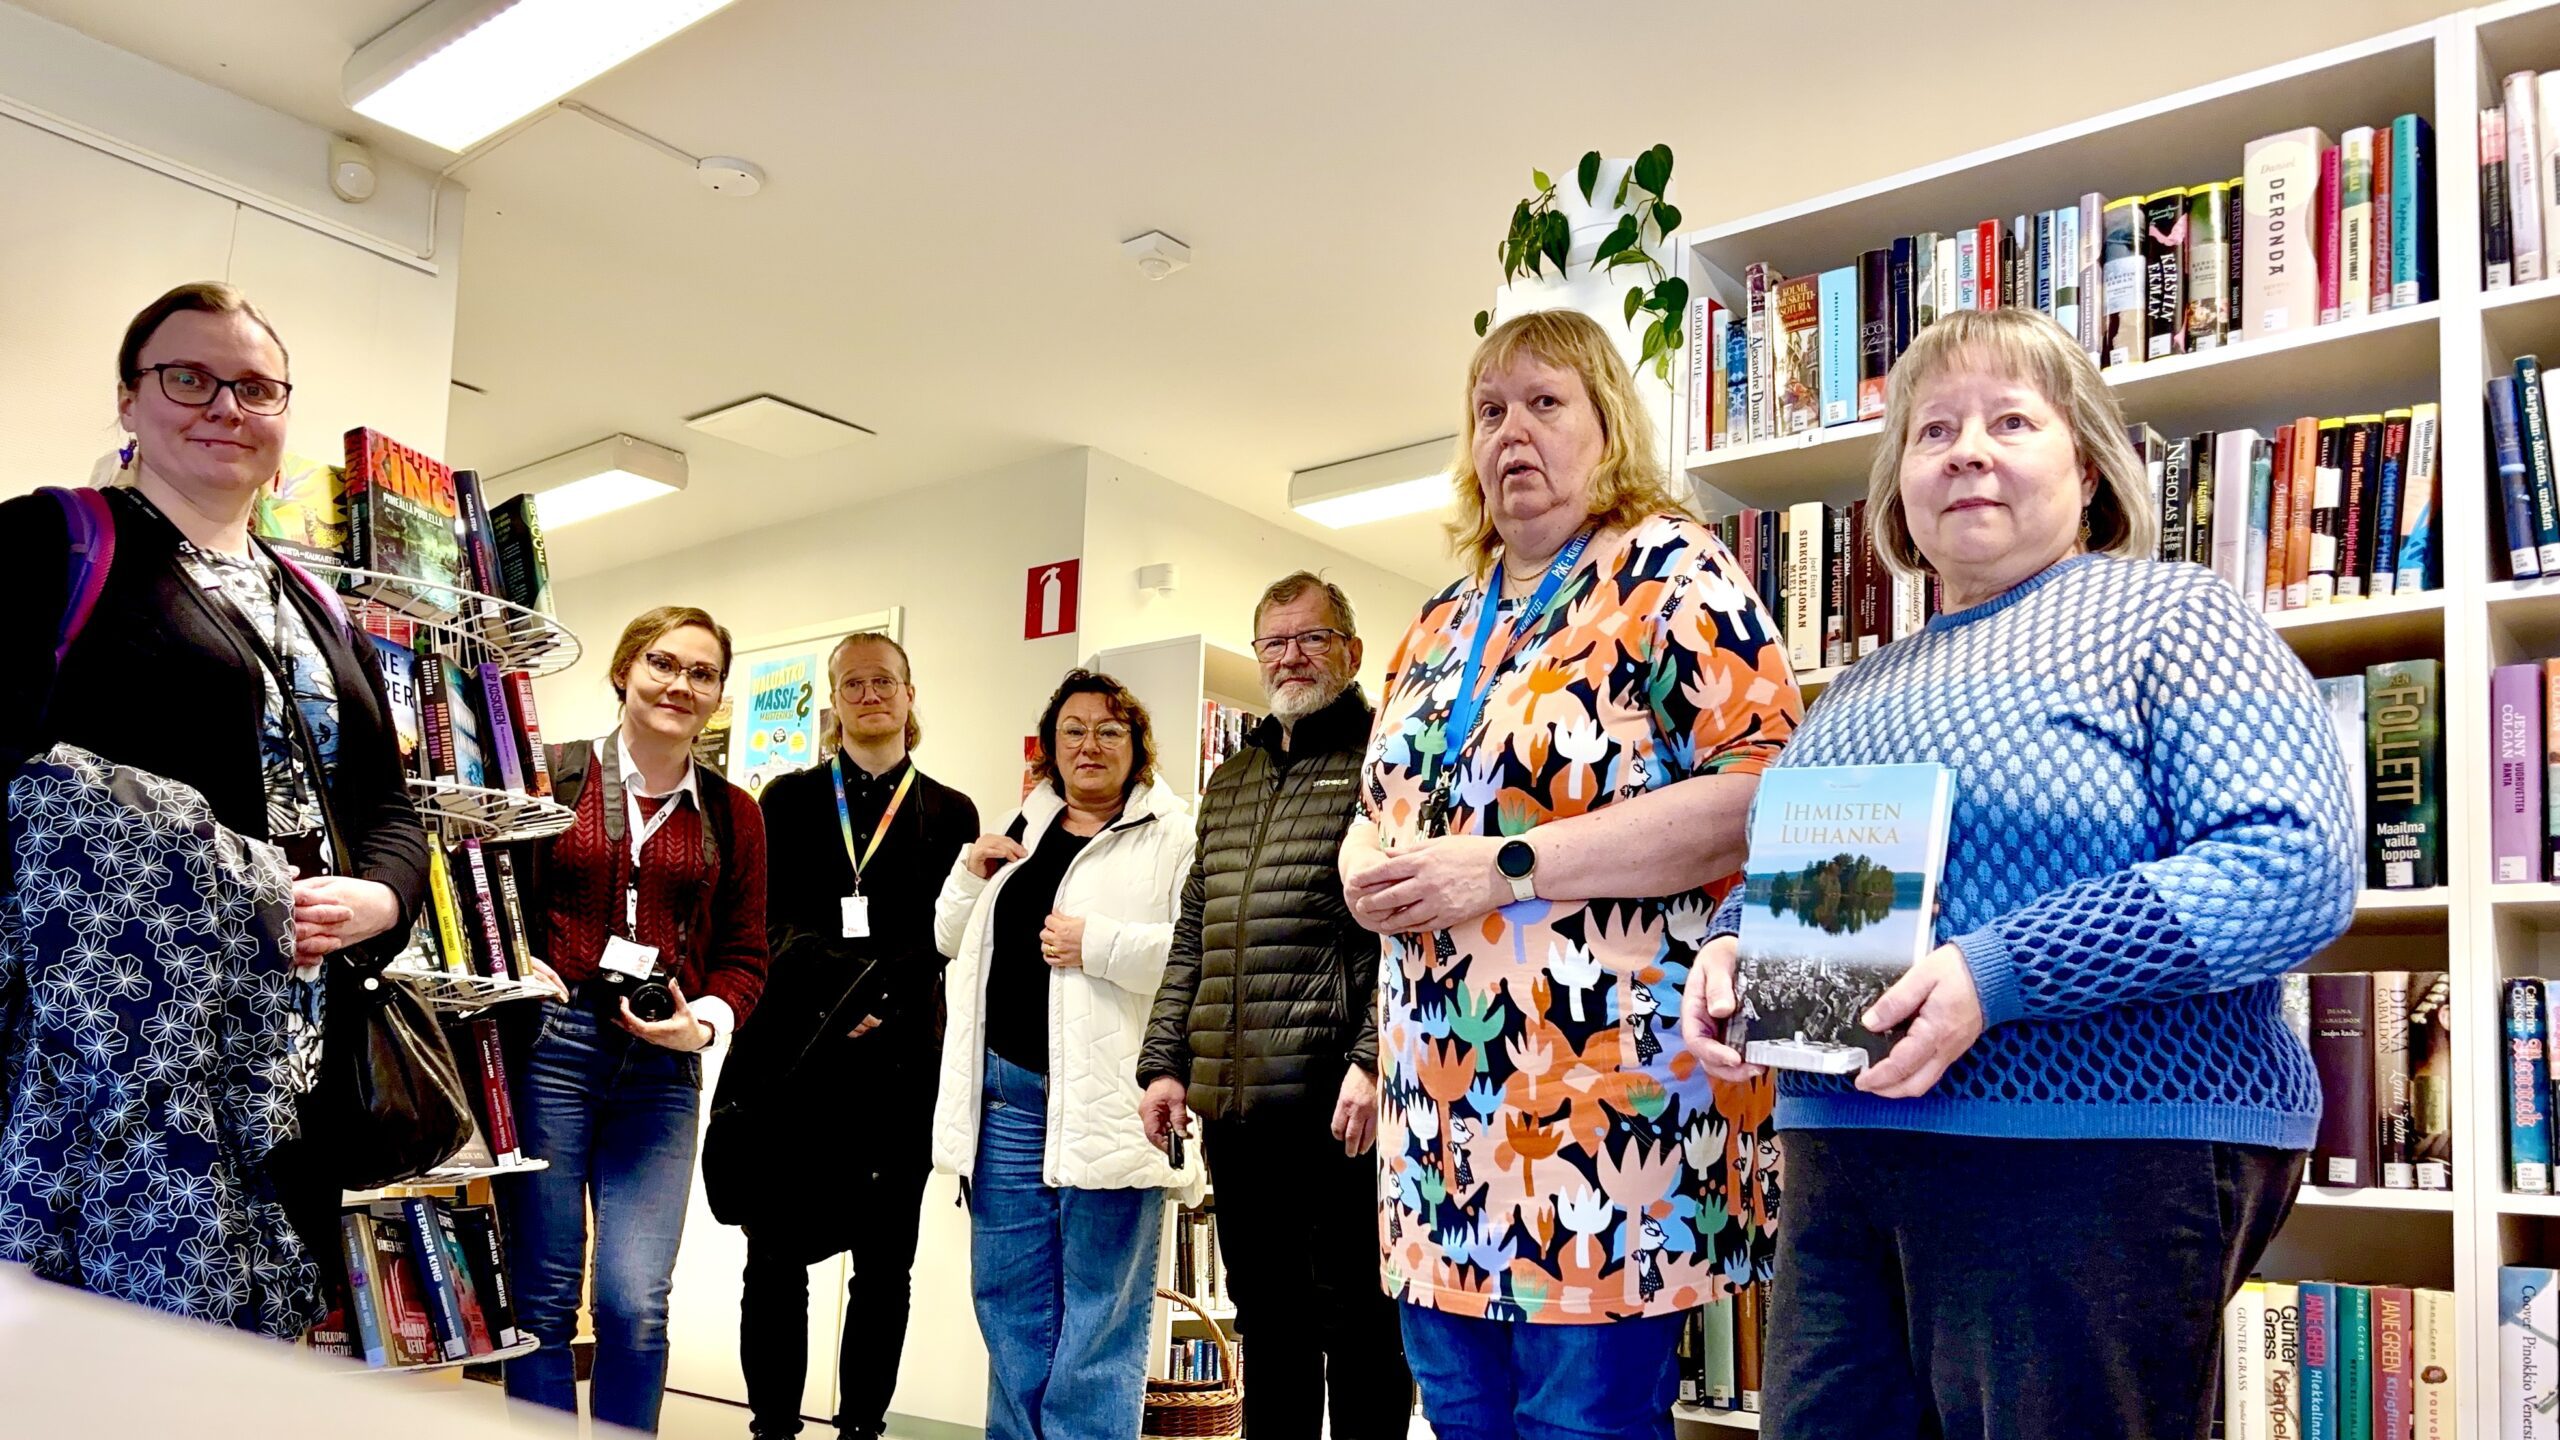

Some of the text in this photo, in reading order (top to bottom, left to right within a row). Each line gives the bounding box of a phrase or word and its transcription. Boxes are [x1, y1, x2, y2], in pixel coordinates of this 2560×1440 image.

[2232, 197, 2241, 241] KERSTIN
[2268, 177, 2286, 276] DERONDA
[1959, 243, 1975, 304] Dorothy Eden
[2041, 234, 2052, 271] Ehrlich
[2231, 242, 2240, 280] EKMAN
[1781, 282, 1809, 296] KOLME
[2147, 261, 2160, 320] EKMAN
[2160, 252, 2178, 323] KERSTIN
[1694, 304, 1703, 340] RODDY
[1780, 303, 1811, 316] SOTURIA
[1693, 341, 1702, 377] DOYLE
[1750, 336, 1765, 389] Alexandre
[2352, 431, 2366, 466] William
[2522, 367, 2537, 383] Bo
[2538, 487, 2554, 531] uneksin
[368, 449, 456, 518] KING
[2164, 442, 2186, 521] NICHOLAS
[2195, 480, 2208, 526] FAGERHOLM
[383, 491, 443, 528] PIMEÄLLÄ PUOLELLA
[465, 493, 474, 517] CAMILLA
[469, 516, 478, 532] STEN
[1834, 517, 1843, 533] Ben
[1798, 529, 1808, 628] SIRKUSLEIJONAN
[1809, 557, 1817, 575] Joel
[485, 670, 496, 682] JP
[2389, 672, 2411, 686] KEN
[490, 682, 507, 726] KOSKINEN
[754, 687, 798, 712] MASSI-
[2375, 685, 2426, 805] FOLLETT
[2502, 704, 2513, 759] COLGAN
[2514, 712, 2526, 757] JENNY
[2503, 762, 2513, 787] RANTA
[2514, 761, 2526, 814] VUOROVETTEN
[1784, 800, 1903, 821] IHMISTEN
[2376, 822, 2425, 836] Maailma
[1781, 824, 1900, 845] LUHANKA
[2381, 848, 2421, 862] loppua
[2385, 835, 2417, 848] vailla
[469, 848, 482, 868] ANU
[481, 900, 505, 969] TAIVASVERKKO
[2377, 988, 2390, 1055] GABALDON
[2391, 989, 2408, 1055] DIANA
[2512, 986, 2524, 1032] Cookson
[2525, 984, 2538, 1034] Catherine
[483, 1039, 493, 1063] CAMILLA
[487, 1062, 496, 1077] STEN
[2389, 1069, 2409, 1106] Lordi
[2512, 1037, 2543, 1129] Hannah
[2389, 1108, 2410, 1144] John
[413, 1203, 435, 1254] STEPHEN
[427, 1254, 443, 1282] KING
[488, 1229, 499, 1251] MARKO
[2305, 1292, 2325, 1325] JANE
[2357, 1291, 2366, 1361] Jane Green
[2381, 1296, 2401, 1331] JANE
[2521, 1284, 2537, 1330] Coover
[314, 1343, 353, 1357] RAKASTAVA
[2238, 1306, 2248, 1391] GÜNTER GRASS
[2264, 1307, 2280, 1360] Grass
[2280, 1304, 2299, 1368] Günter
[2305, 1325, 2325, 1367] GREEN
[2382, 1331, 2401, 1374] GREEN
[2523, 1335, 2537, 1391] Pinokkio
[2270, 1369, 2291, 1440] Kampel
